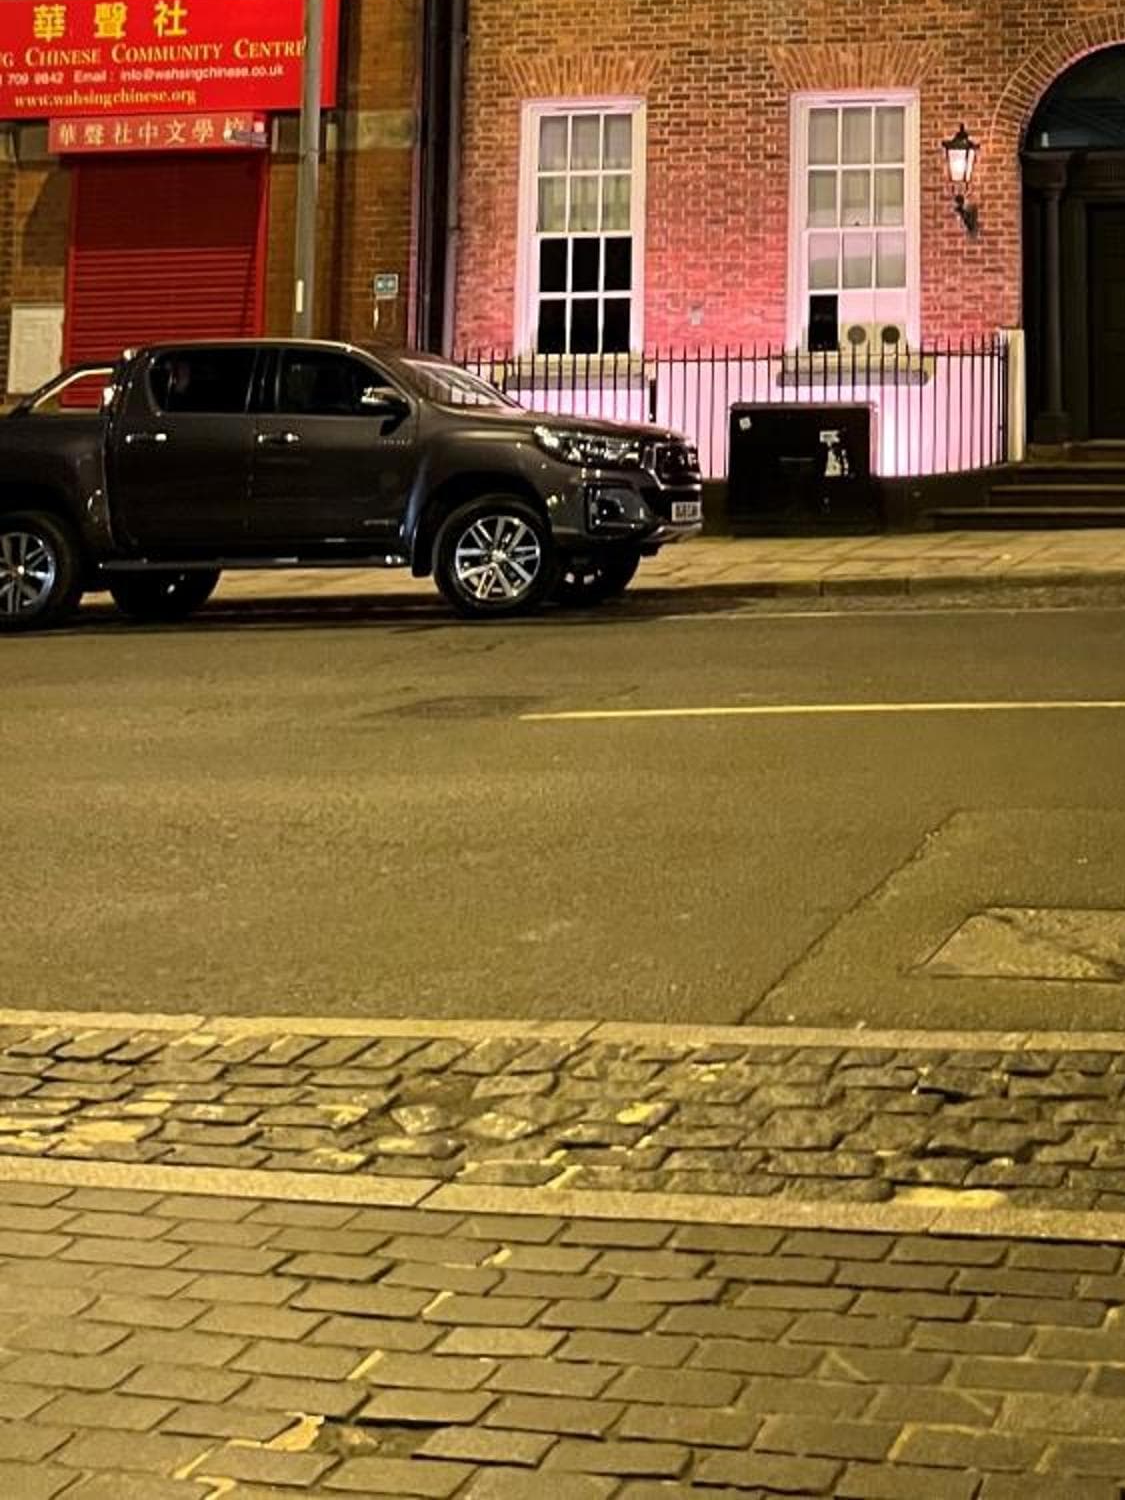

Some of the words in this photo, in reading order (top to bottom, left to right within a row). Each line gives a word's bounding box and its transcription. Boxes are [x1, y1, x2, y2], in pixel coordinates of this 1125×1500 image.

[25, 47, 101, 67] CHINESE
[111, 41, 224, 64] COMMUNITY
[234, 37, 306, 59] CENTRE
[74, 69, 107, 83] Email
[15, 88, 197, 109] www.wahsingchinese.org
